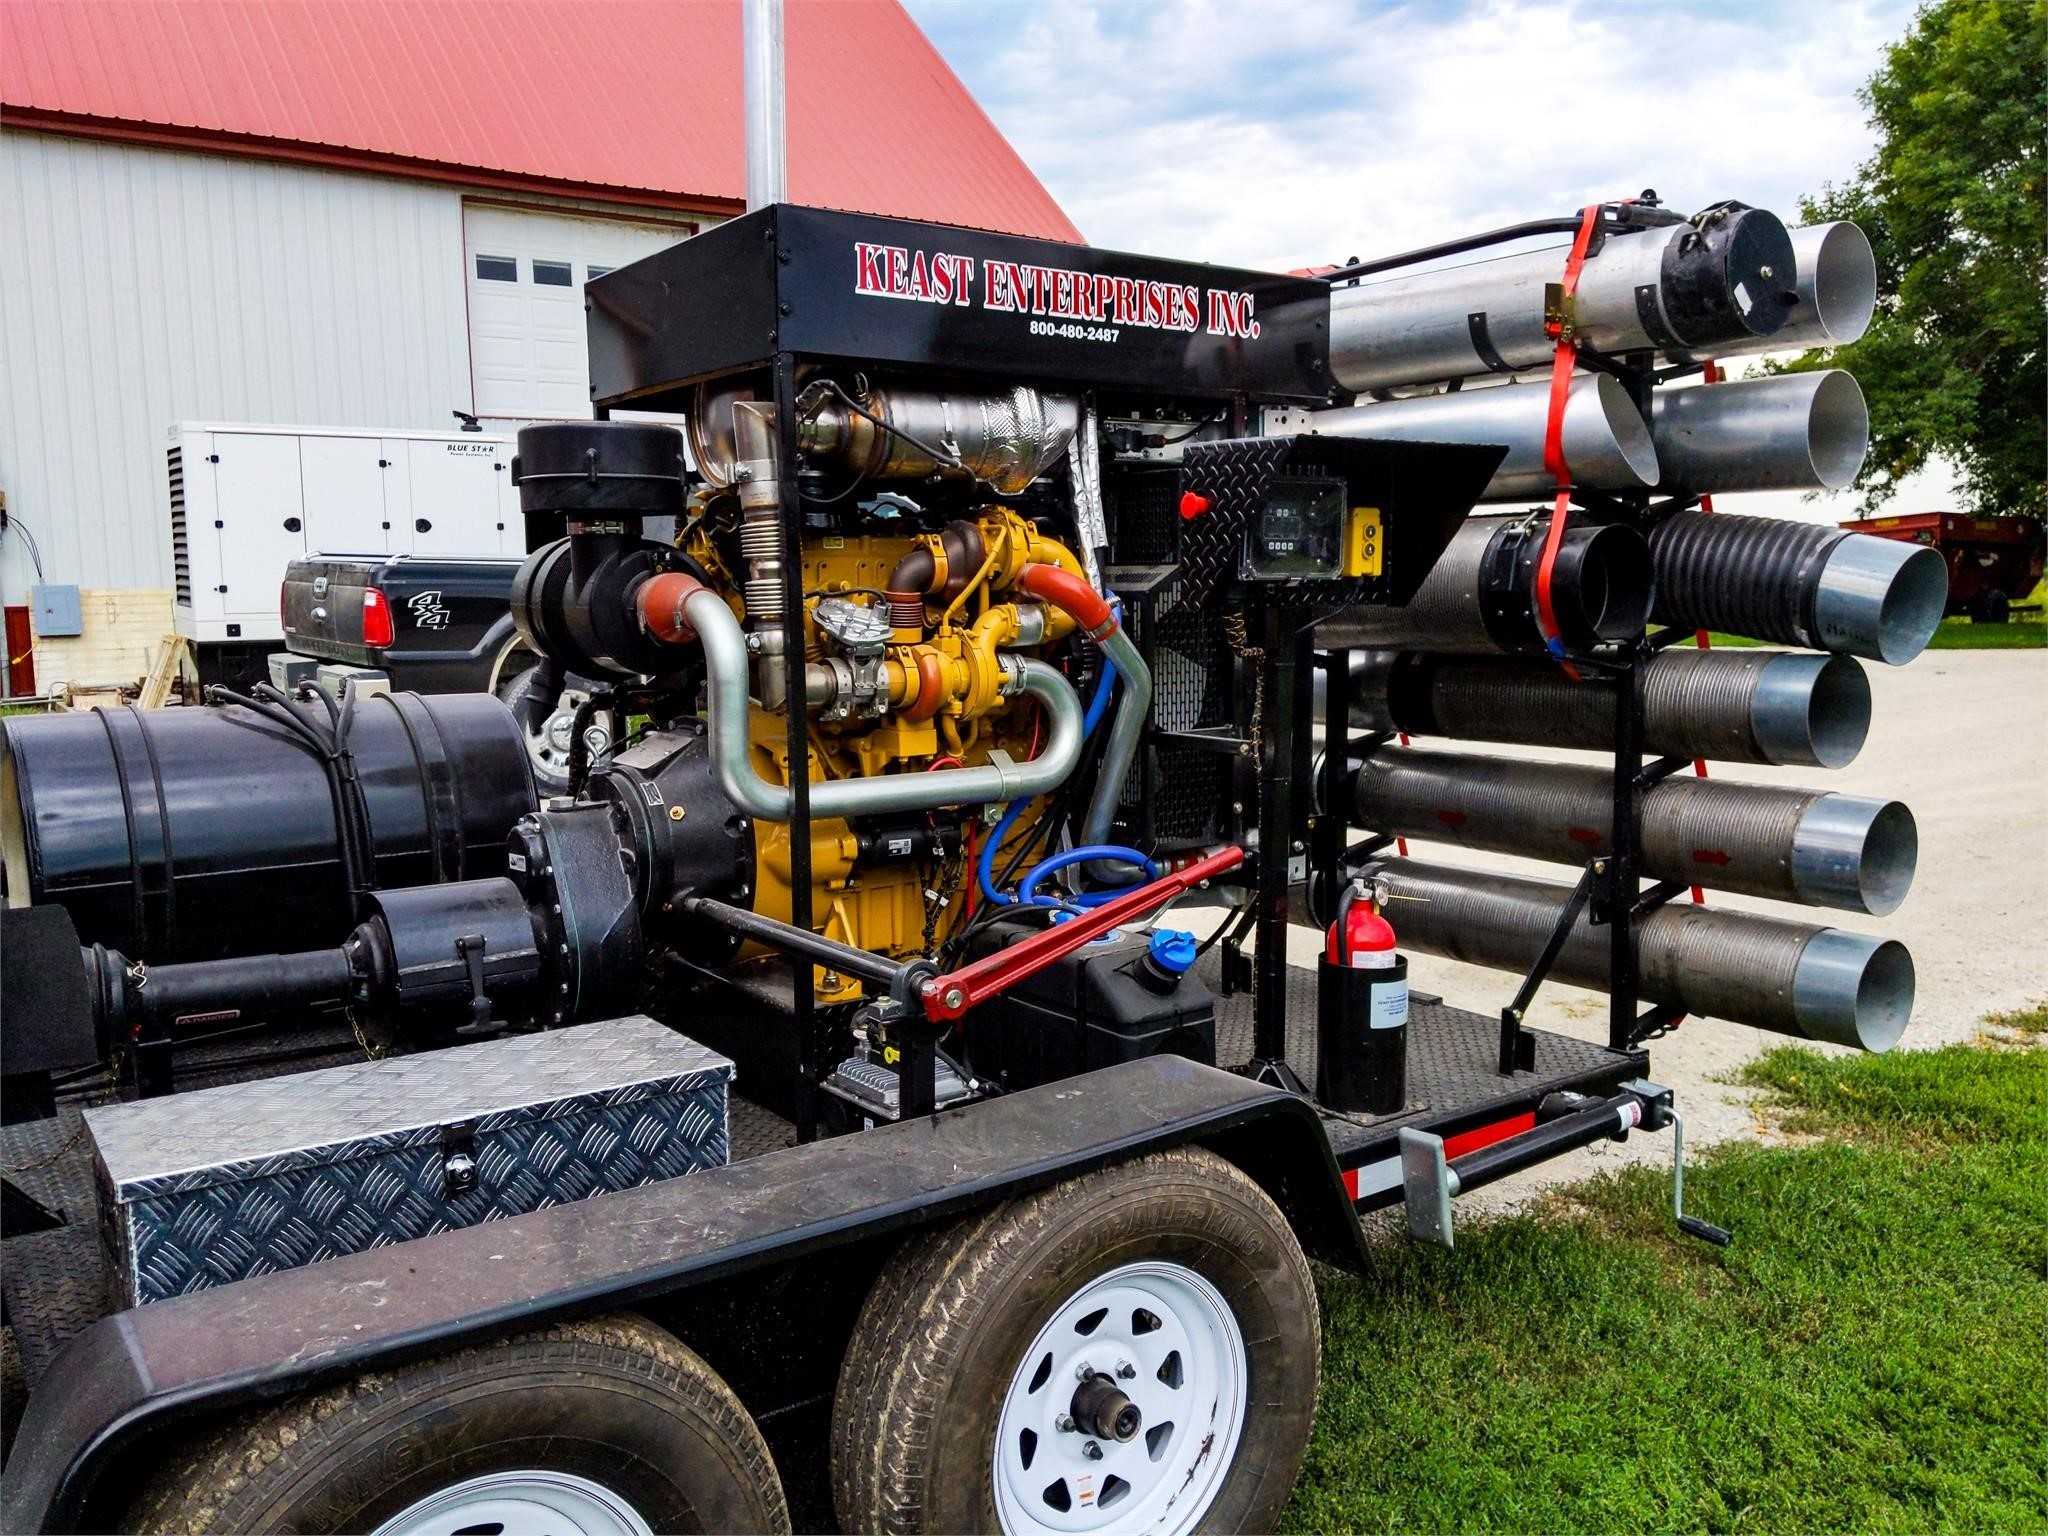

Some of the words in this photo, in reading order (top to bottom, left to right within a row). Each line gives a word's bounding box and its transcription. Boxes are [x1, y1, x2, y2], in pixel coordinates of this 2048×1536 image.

[855, 242, 974, 307] KEAST
[983, 259, 1200, 332] ENTERPRISES
[1206, 289, 1261, 339] INC.
[1029, 320, 1120, 344] 800-480-2487
[447, 444, 468, 452] BLUE
